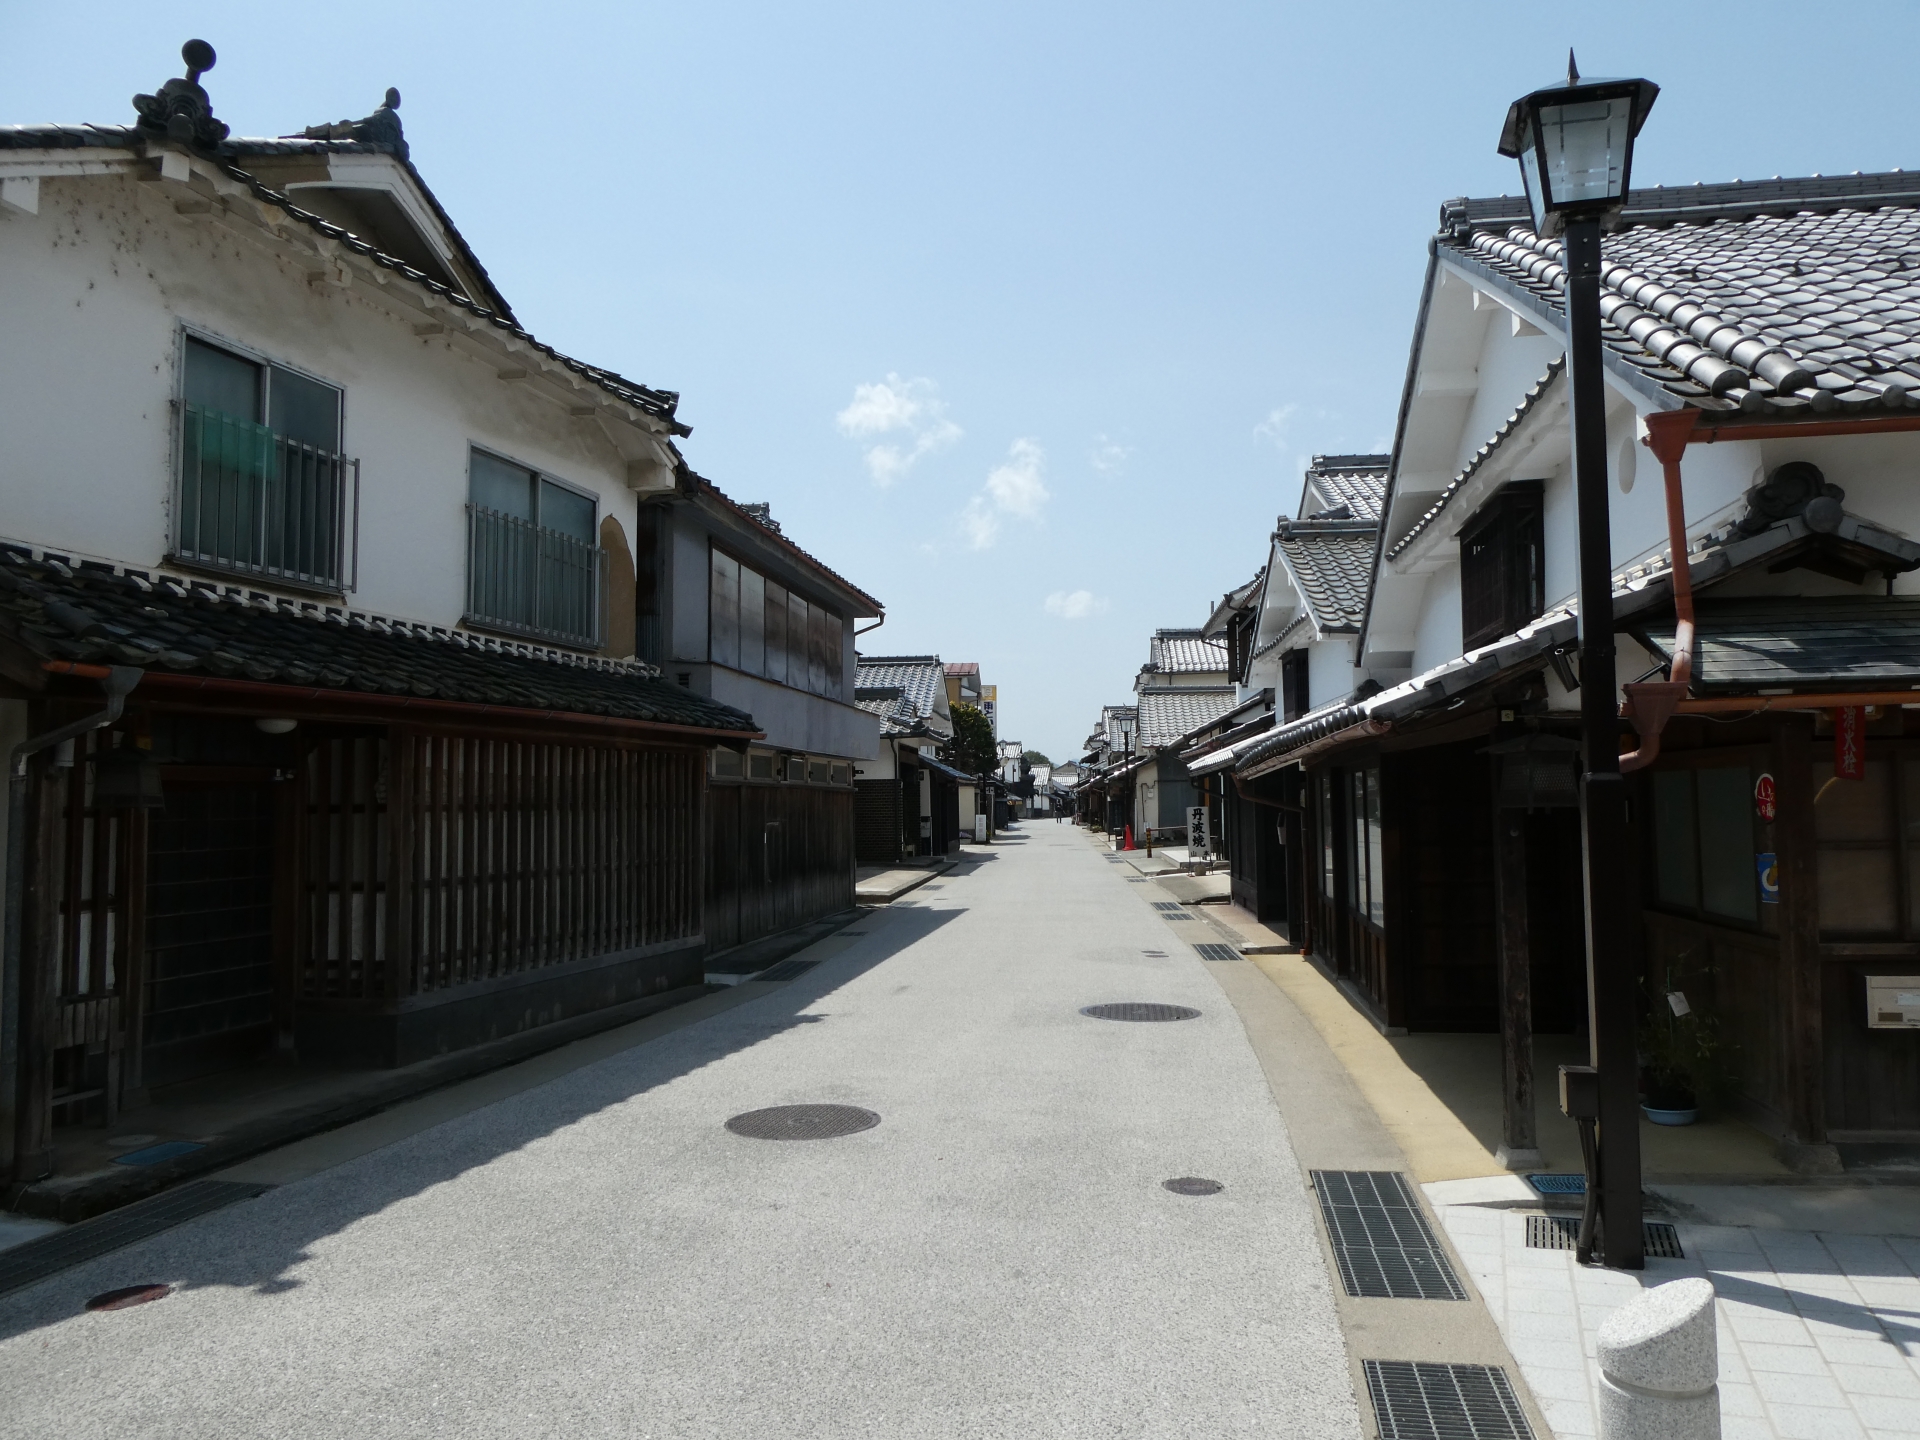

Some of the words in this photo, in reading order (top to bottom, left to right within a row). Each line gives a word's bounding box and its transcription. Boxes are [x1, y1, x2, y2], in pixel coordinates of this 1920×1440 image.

[1842, 705, 1857, 774] 消火栓
[1191, 807, 1207, 848] 丹波焼
